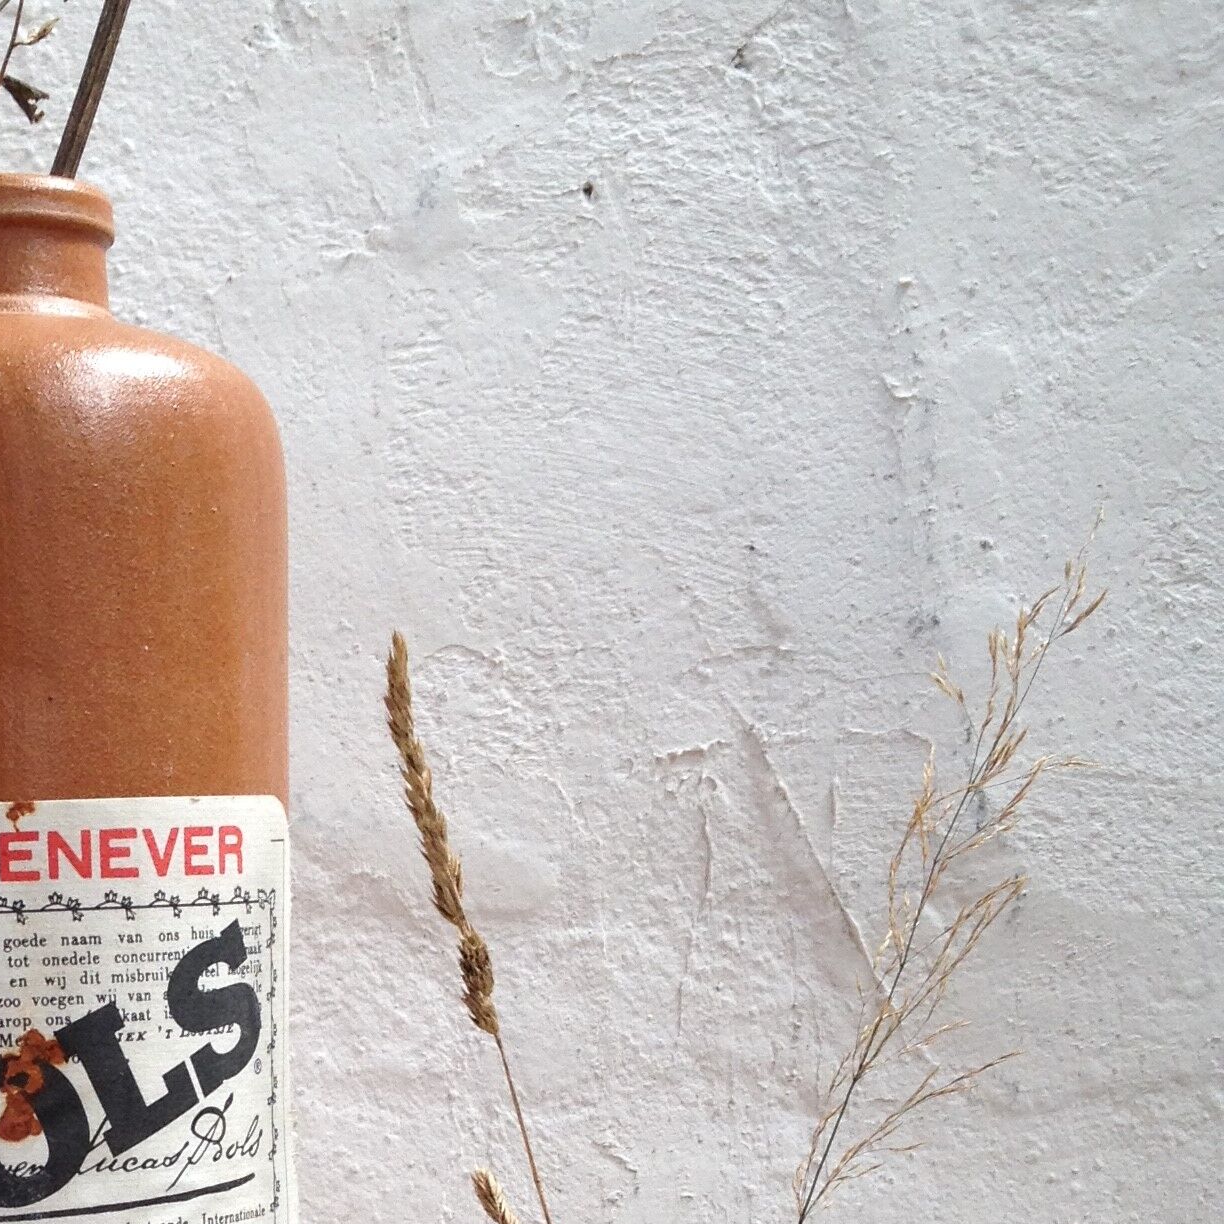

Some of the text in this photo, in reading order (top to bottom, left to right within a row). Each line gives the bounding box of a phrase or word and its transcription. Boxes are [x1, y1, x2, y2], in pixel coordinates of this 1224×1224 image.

[3, 934, 47, 952] goede
[60, 935, 102, 947] naam
[118, 933, 143, 944] van
[159, 931, 180, 942] ons
[191, 926, 215, 941] huis
[7, 954, 30, 969] tot
[42, 949, 100, 966] onedele
[9, 976, 27, 988] en
[44, 974, 67, 990] wij
[79, 970, 101, 985] dit
[111, 966, 173, 984] misbruik
[33, 993, 85, 1010] voegen
[96, 988, 117, 1003] wij
[128, 991, 152, 1002] van
[45, 1014, 72, 1027] ons
